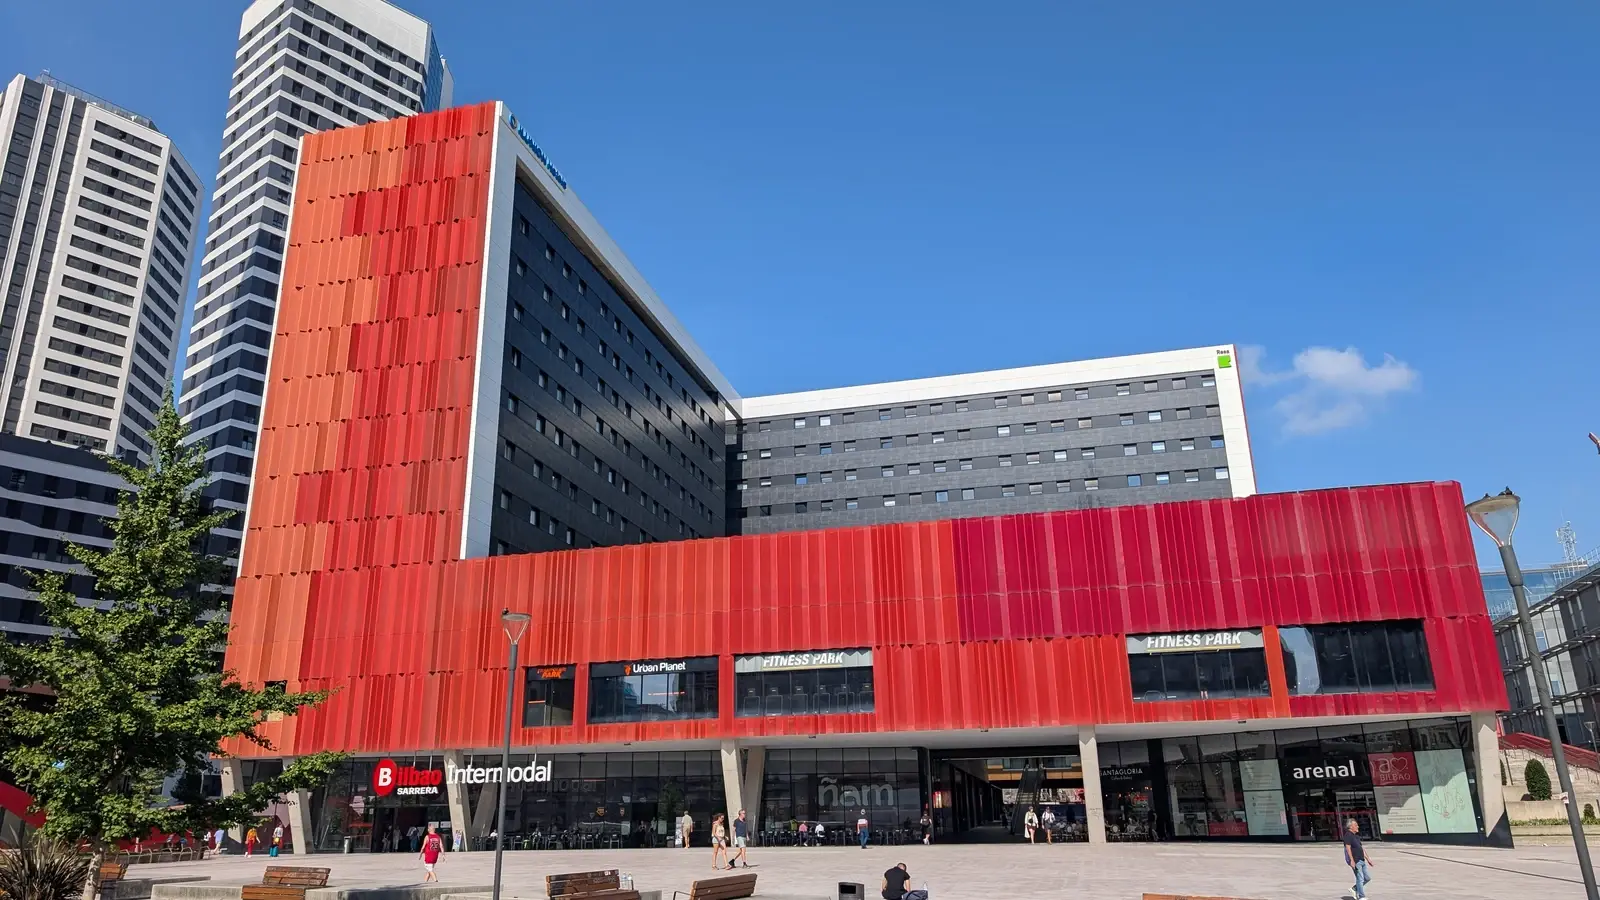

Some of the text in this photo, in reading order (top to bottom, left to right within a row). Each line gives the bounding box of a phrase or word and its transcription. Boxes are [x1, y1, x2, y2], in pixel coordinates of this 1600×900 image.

[1147, 631, 1242, 649] FITNESS PARK
[632, 661, 686, 673] Urban Planet
[763, 651, 845, 667] FITNESS PARK
[378, 760, 552, 787] Bilbao Intermodal
[1293, 759, 1356, 779] arenal
[1380, 773, 1411, 781] BILBAO
[397, 786, 439, 795] SARRERA
[818, 776, 894, 807] ñam
